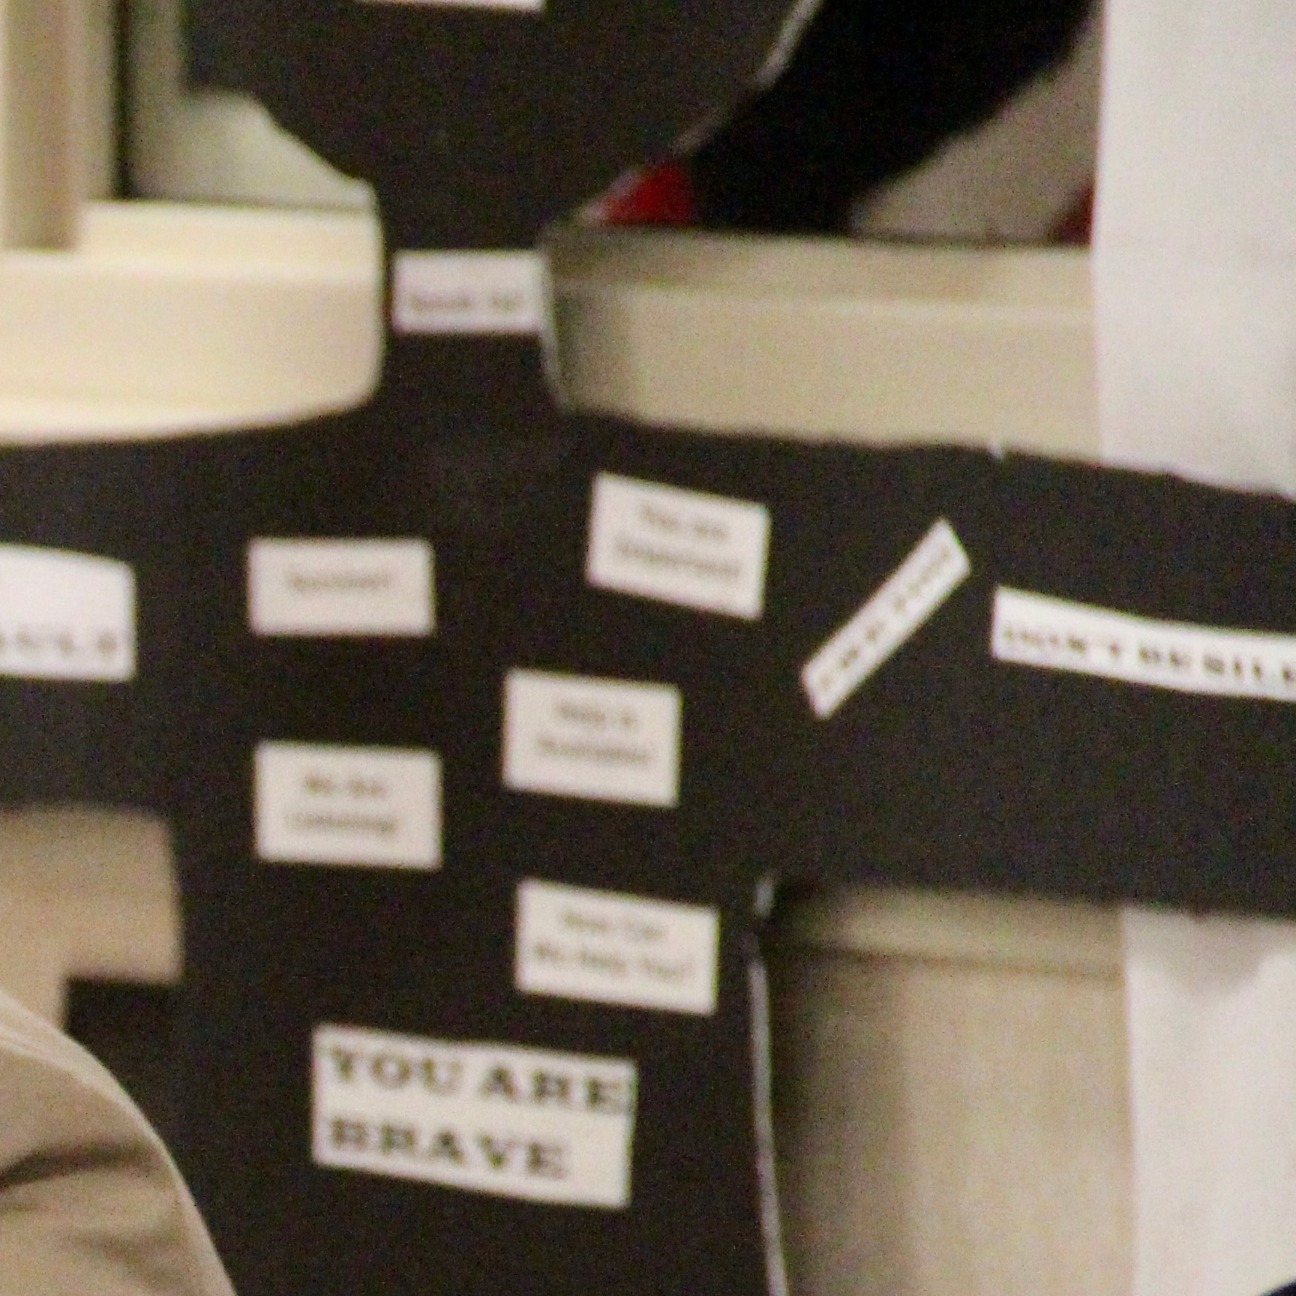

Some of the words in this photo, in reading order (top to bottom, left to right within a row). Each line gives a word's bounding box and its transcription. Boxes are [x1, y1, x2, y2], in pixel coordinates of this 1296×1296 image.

[328, 1046, 464, 1096] YOU
[478, 1064, 630, 1116] ARE
[329, 1116, 570, 1182] BRAVE
